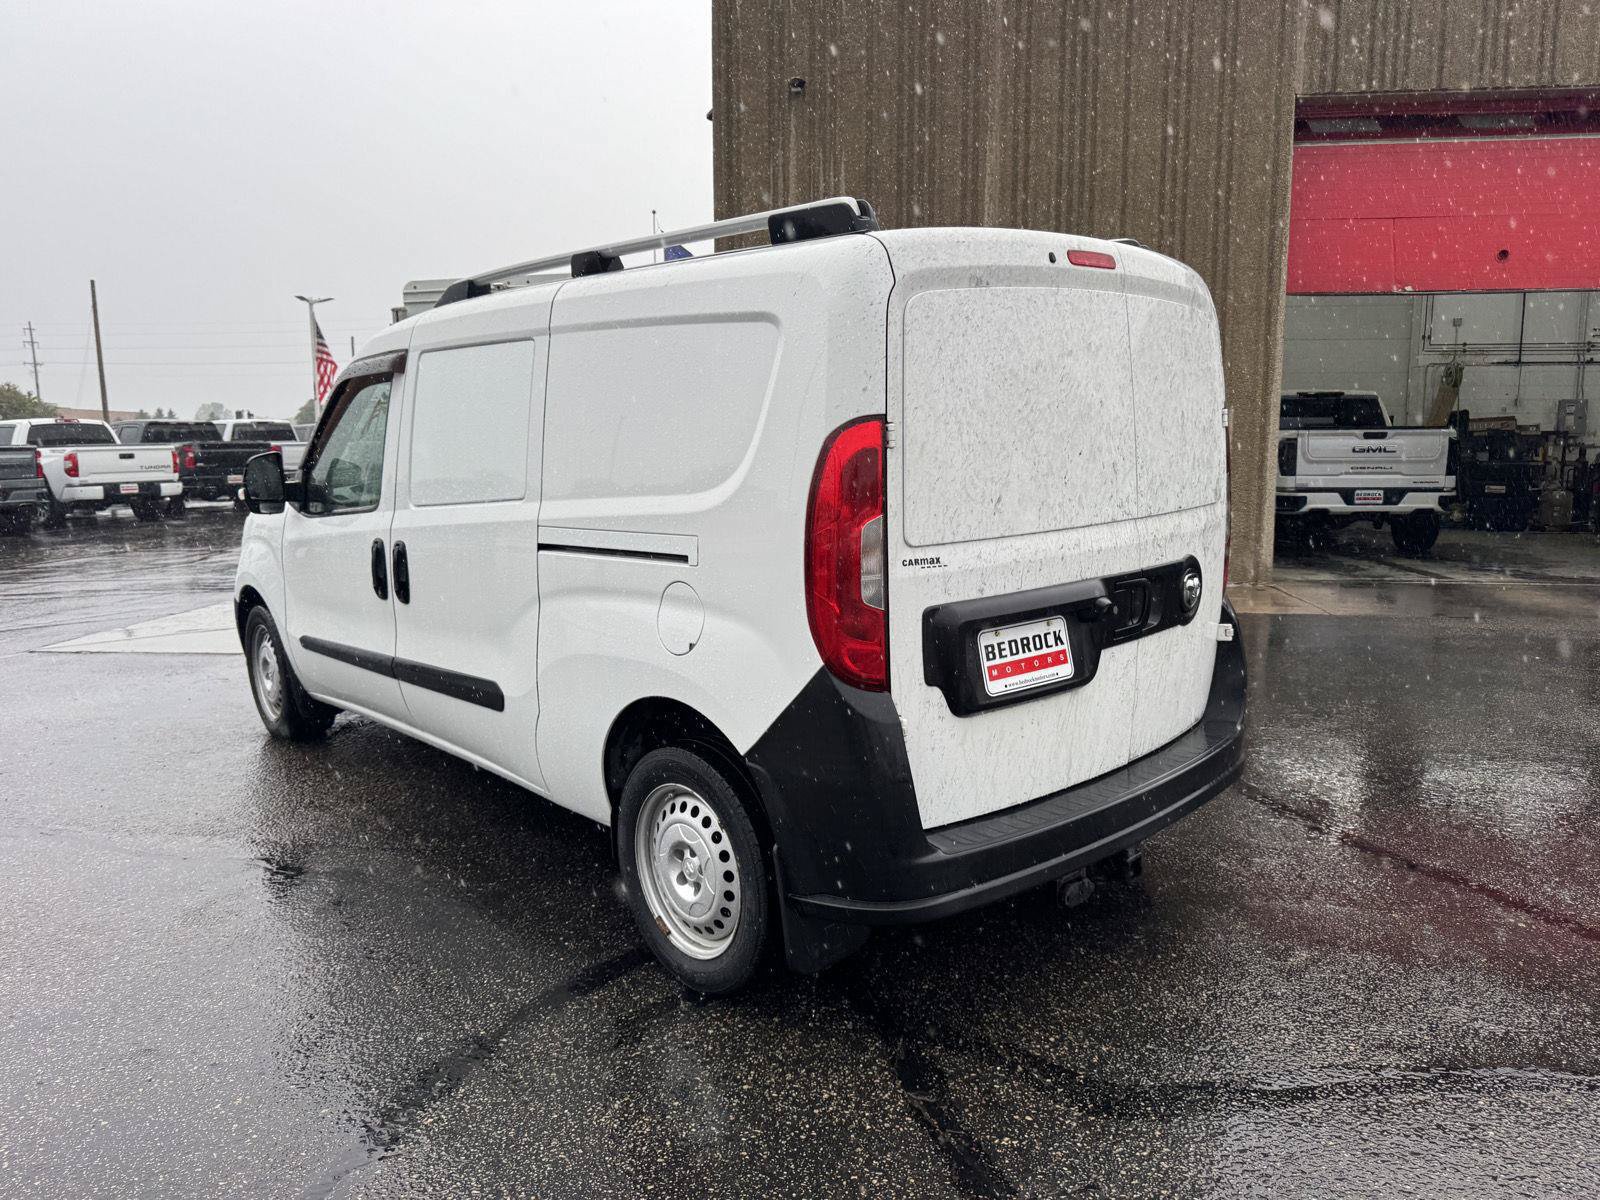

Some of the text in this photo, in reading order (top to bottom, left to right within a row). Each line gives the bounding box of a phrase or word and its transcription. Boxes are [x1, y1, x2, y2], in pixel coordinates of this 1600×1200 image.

[1352, 445, 1397, 453] GMC
[984, 629, 1065, 662] BEDROCK
[991, 653, 1065, 677] MOTORS
[1008, 672, 1056, 688] www.bedrockmotors.com
